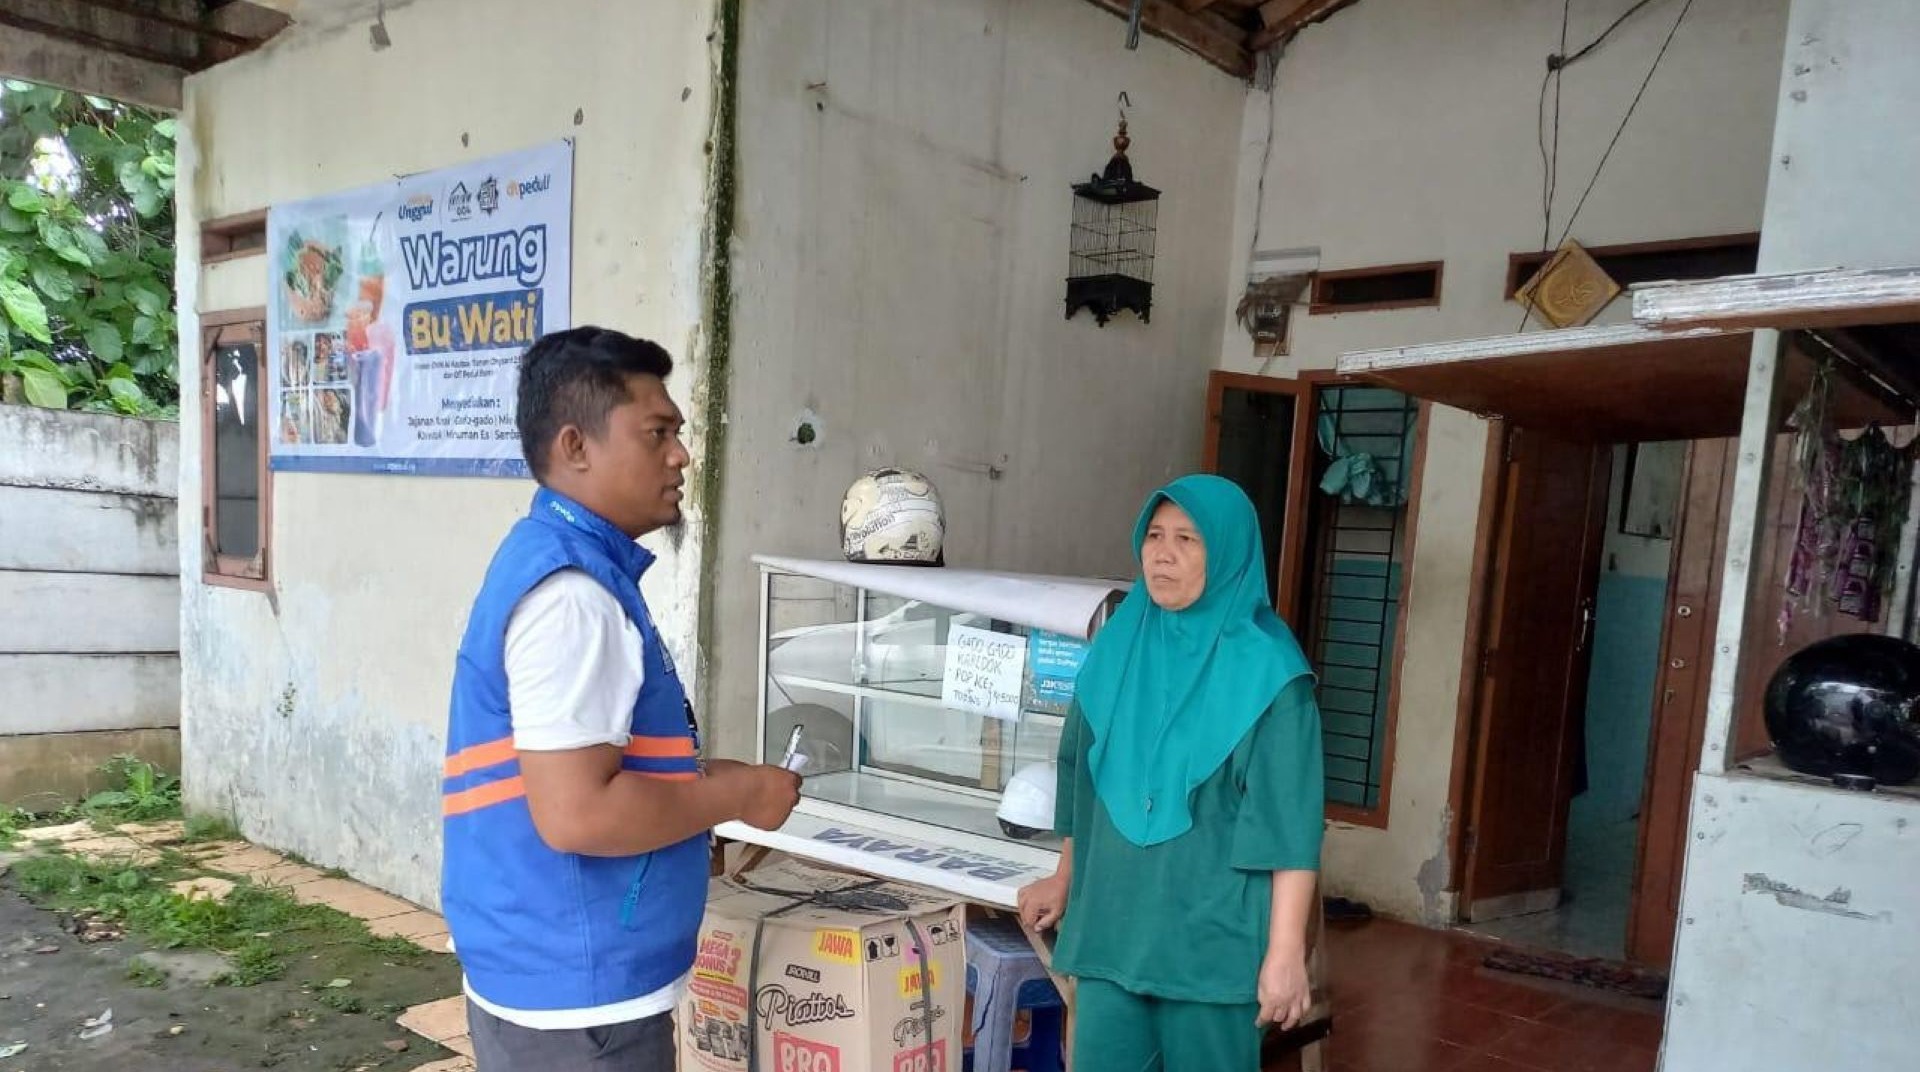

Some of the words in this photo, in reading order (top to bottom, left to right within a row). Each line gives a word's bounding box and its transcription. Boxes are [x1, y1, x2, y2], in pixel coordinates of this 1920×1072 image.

[398, 199, 434, 222] Unggul
[400, 223, 547, 290] Warung
[410, 308, 450, 350] Bu
[458, 292, 537, 345] Wati
[812, 828, 1026, 882] BARAYA
[818, 931, 853, 959] JAWA
[756, 983, 856, 1030] Piattos
